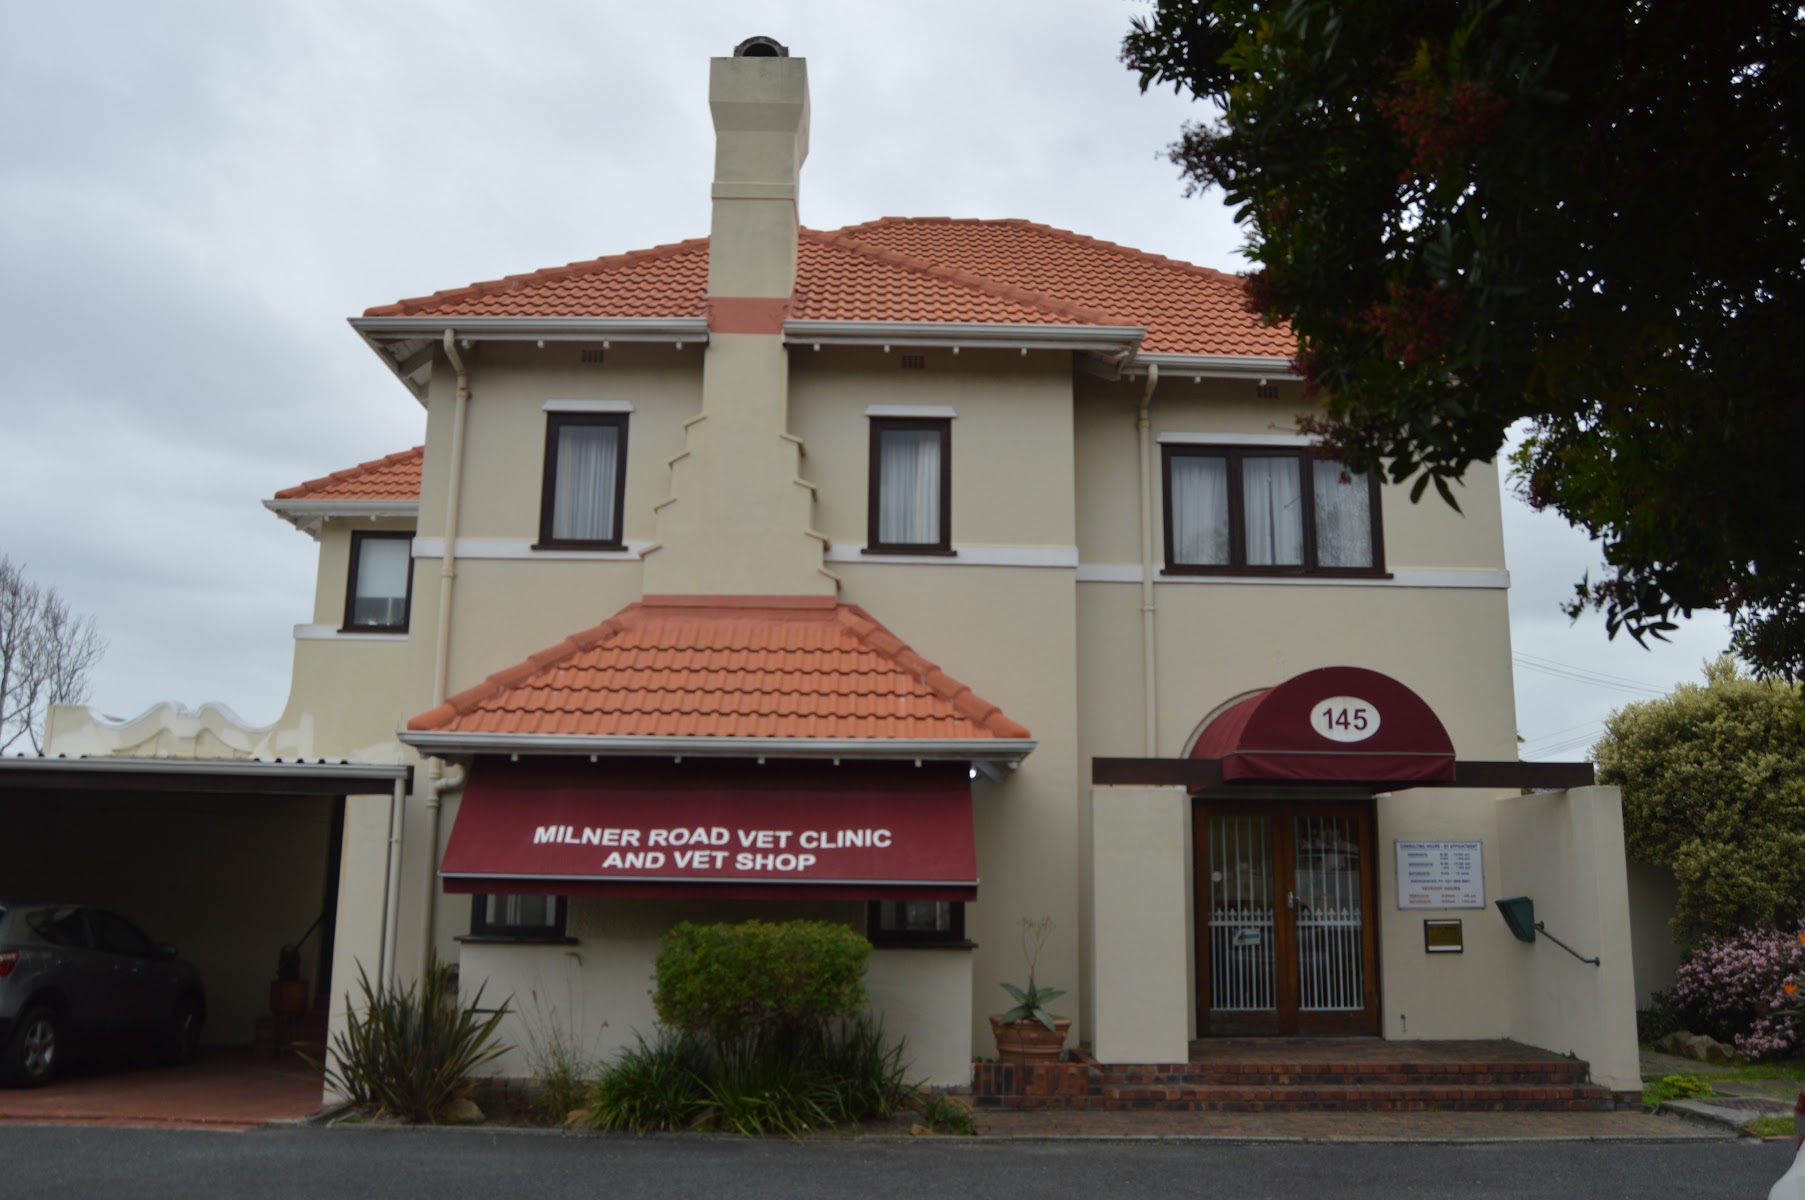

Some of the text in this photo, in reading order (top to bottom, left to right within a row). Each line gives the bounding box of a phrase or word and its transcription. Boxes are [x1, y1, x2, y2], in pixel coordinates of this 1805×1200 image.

[1322, 707, 1368, 731] 145
[533, 825, 893, 849] MILNER ROAD VET CLINIC
[601, 850, 817, 872] AND VET SHOP
